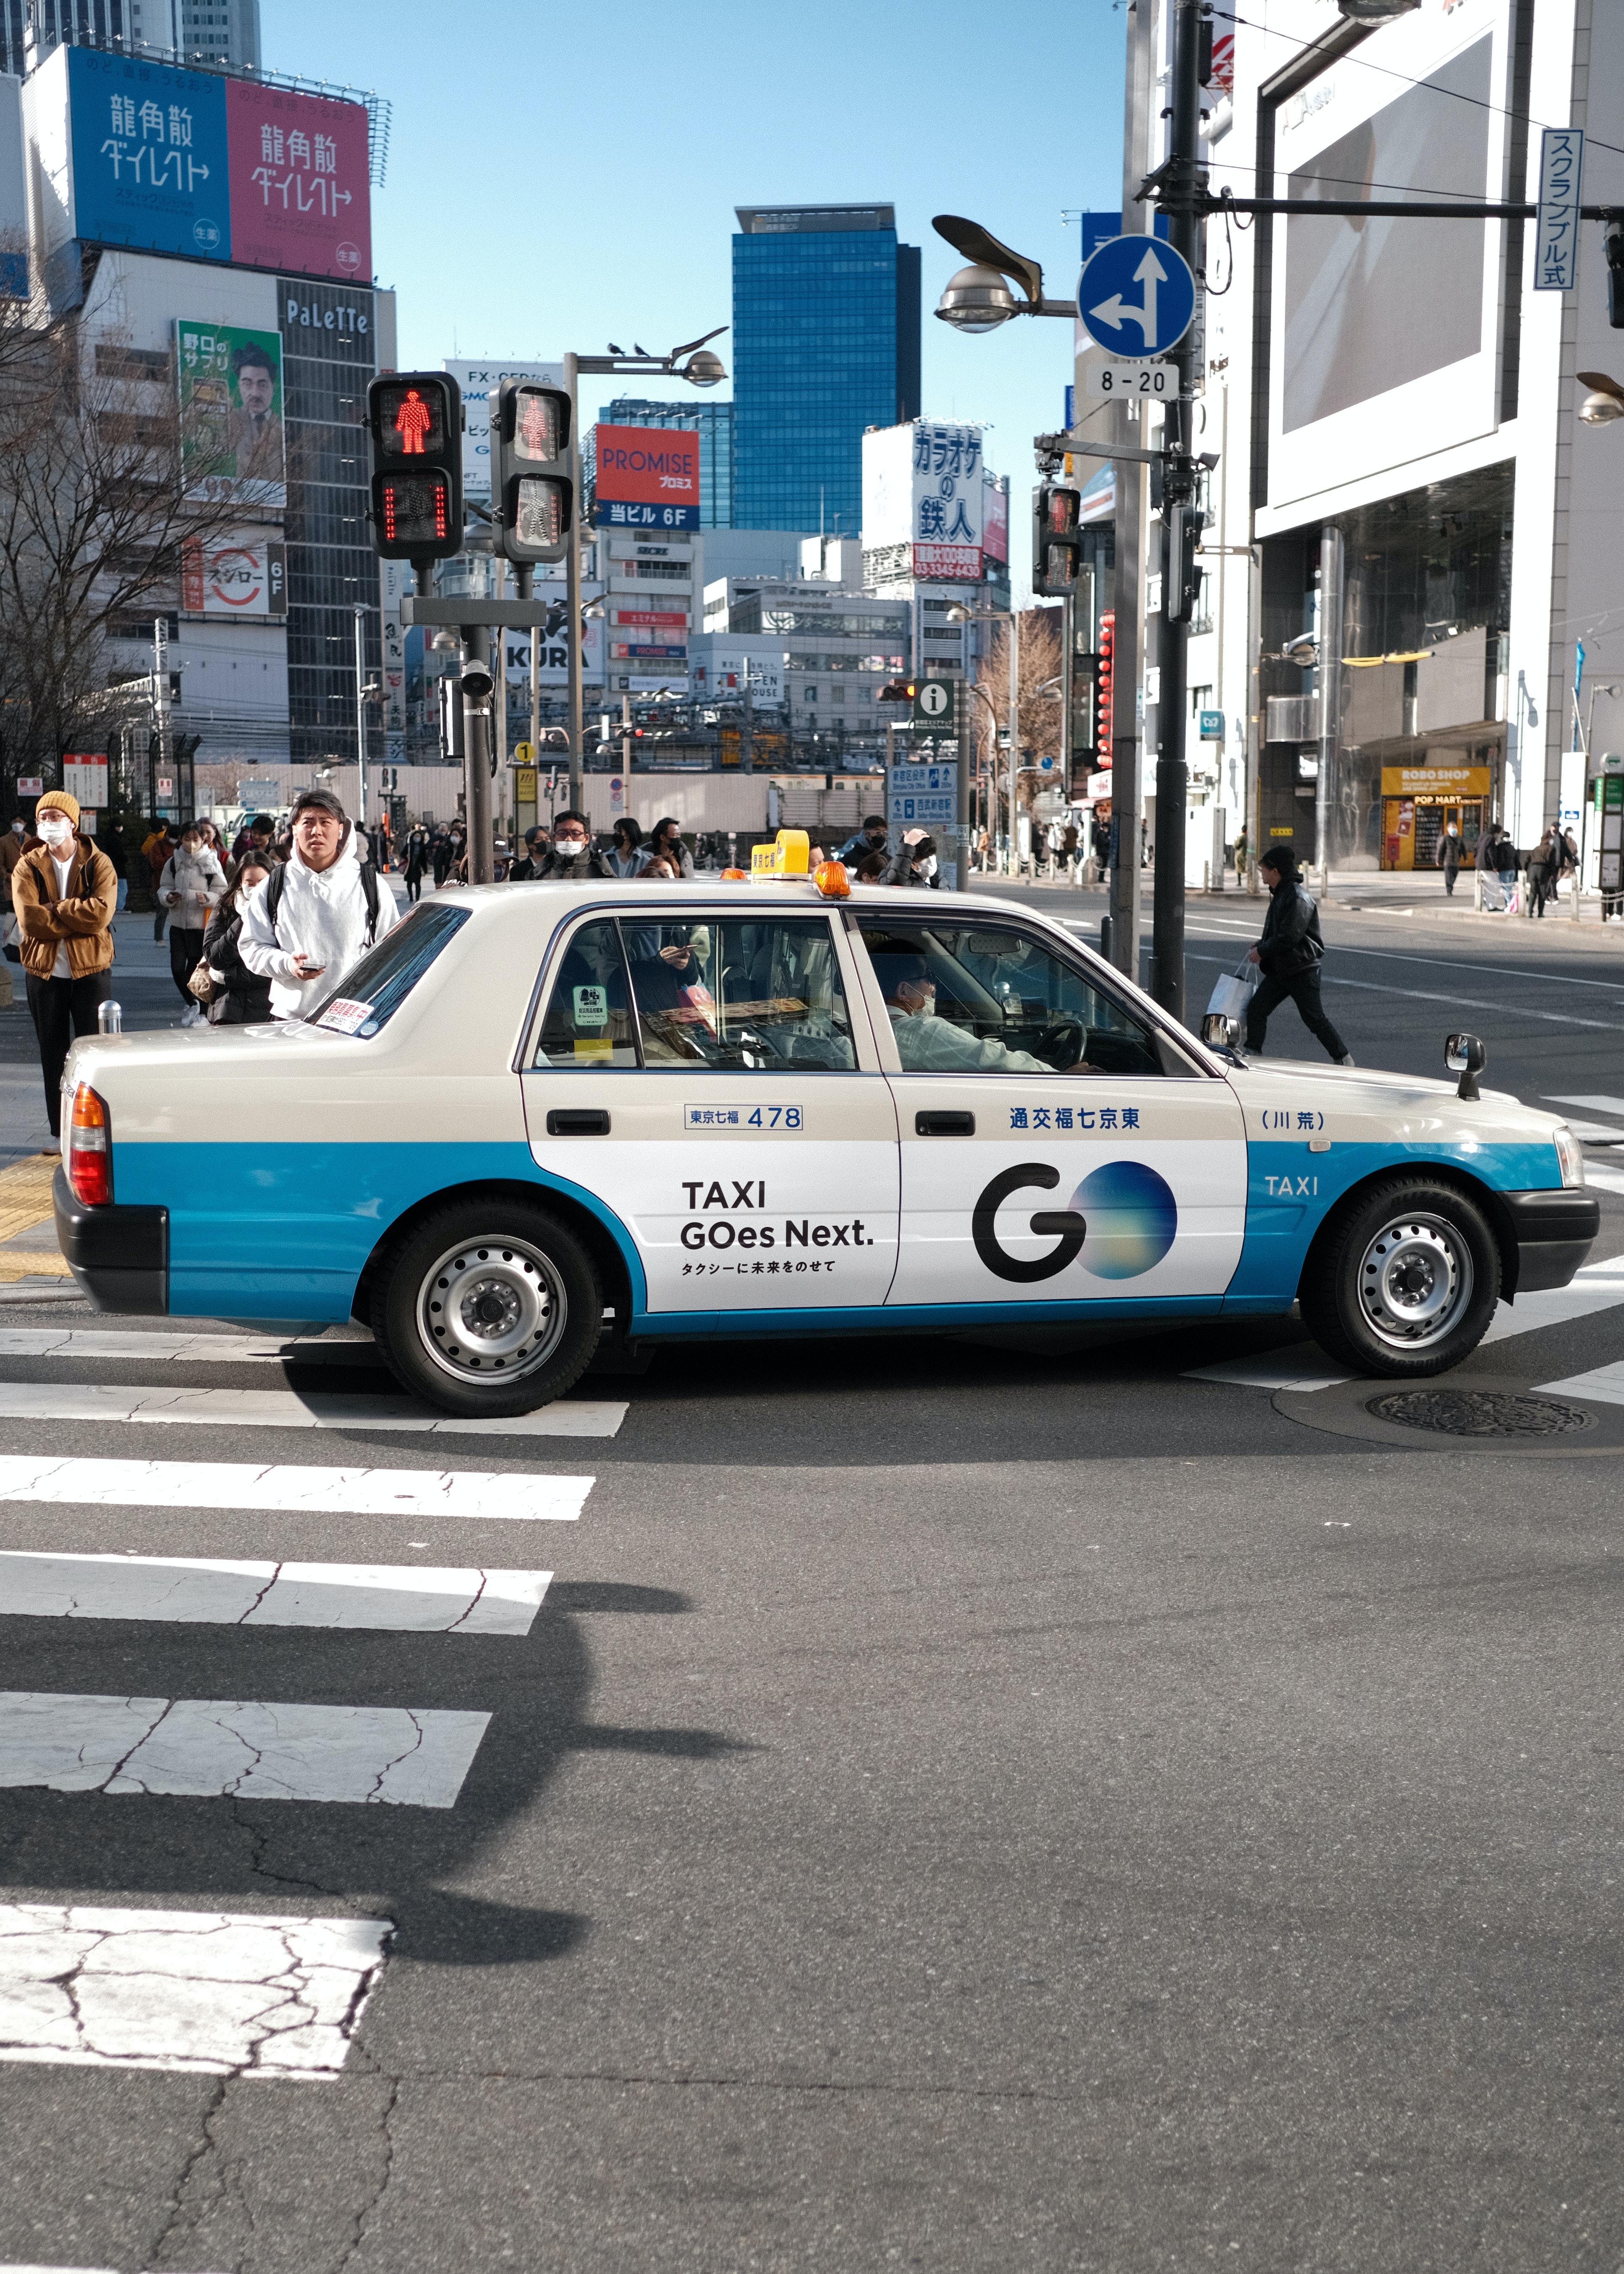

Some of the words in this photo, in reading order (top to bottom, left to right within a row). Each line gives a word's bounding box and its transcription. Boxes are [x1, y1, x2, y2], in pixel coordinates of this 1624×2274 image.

[110, 94, 193, 147] 龍角散
[261, 123, 336, 173] 龍角散
[100, 139, 210, 192] ダイレクト
[251, 167, 352, 217] ダイレクト
[1543, 136, 1573, 285] スクランブル式
[184, 333, 226, 352] 野口の
[603, 448, 693, 475] PROMISE
[915, 425, 982, 479] カラオケ
[610, 504, 656, 523] 当ビル
[663, 508, 686, 525] 6F
[918, 496, 976, 543] 鉄人
[208, 567, 263, 584] スシロー
[1401, 770, 1436, 780] ROBO
[1437, 770, 1470, 780] SHOP
[1414, 796, 1433, 804] POP
[1435, 796, 1462, 804] MART
[754, 852, 775, 868] 東京七福
[690, 1110, 739, 1124] 東京七福
[747, 1107, 801, 1128] 478
[682, 1181, 765, 1209] TAXI
[1265, 1176, 1318, 1196] TAXI
[681, 1221, 775, 1250] GOes
[786, 1220, 874, 1247] Next.
[682, 1260, 836, 1276] タクシーに未来をのせて
